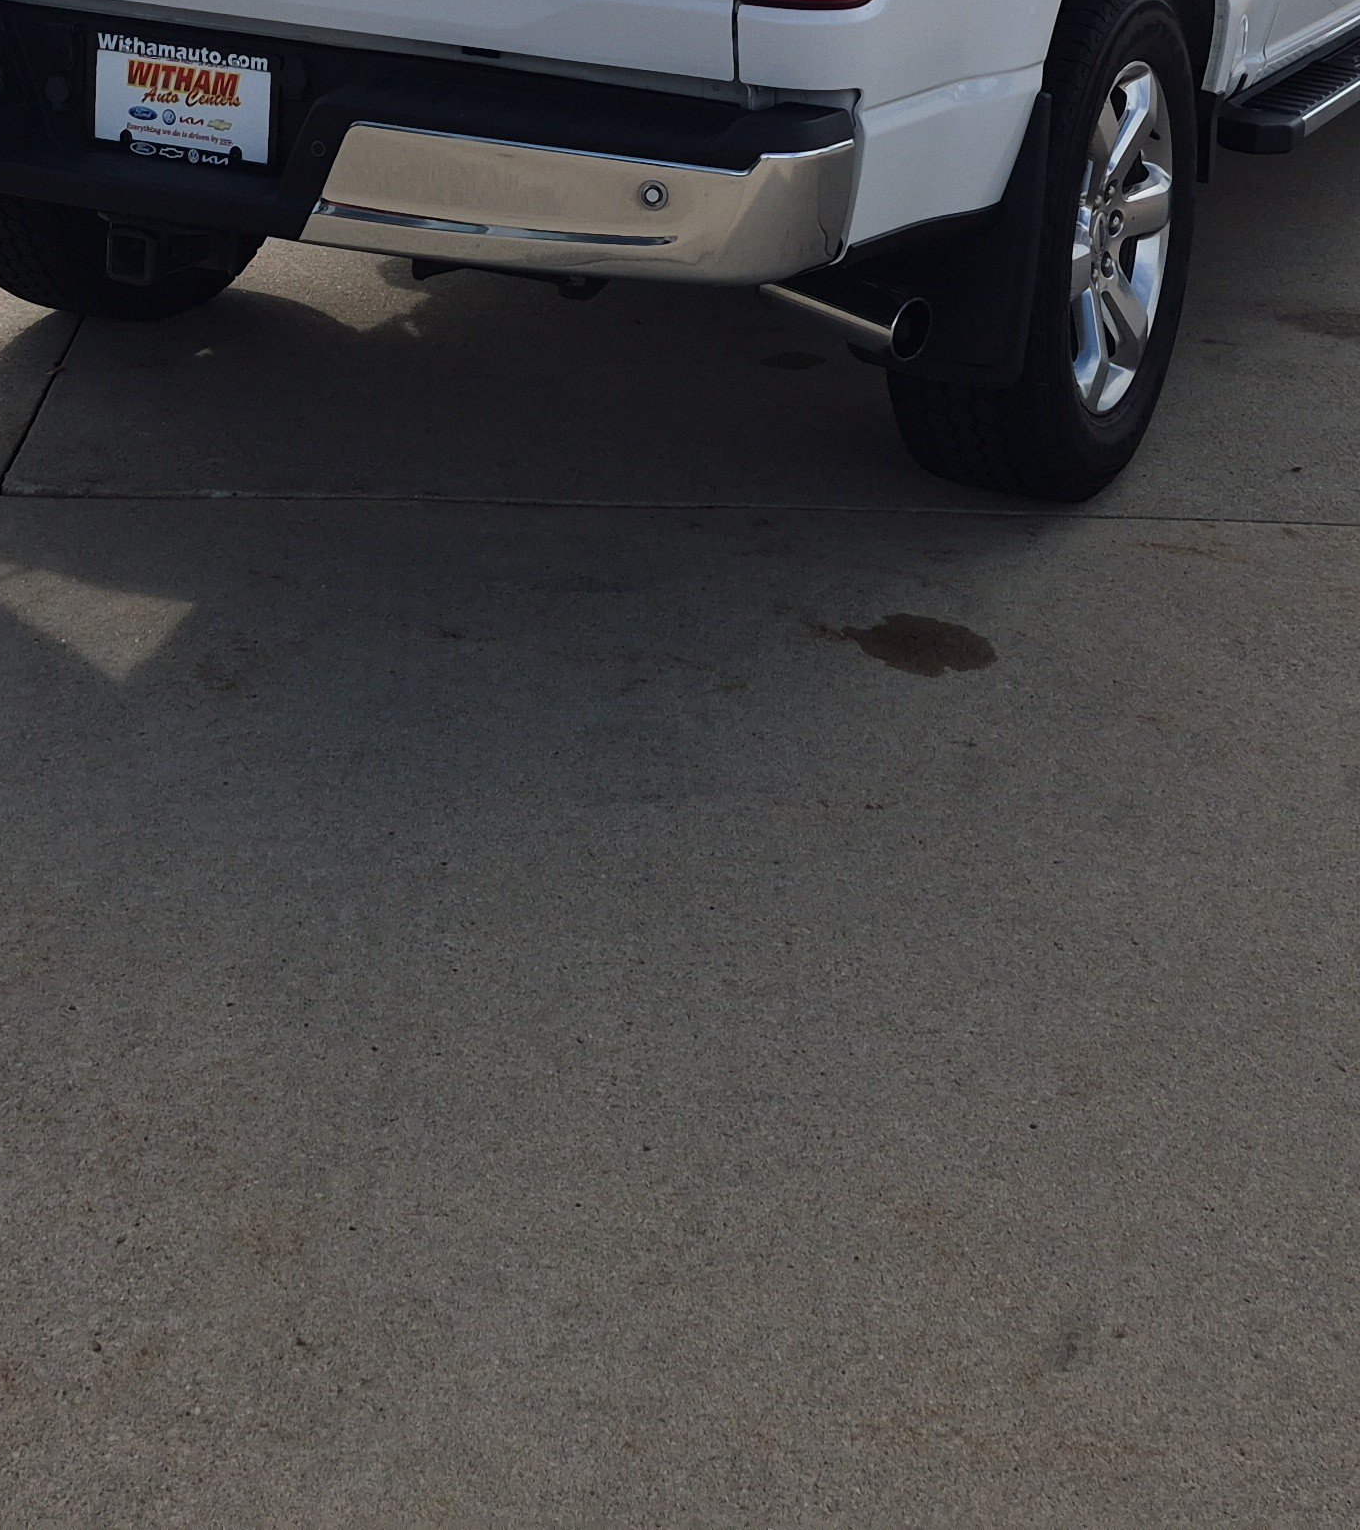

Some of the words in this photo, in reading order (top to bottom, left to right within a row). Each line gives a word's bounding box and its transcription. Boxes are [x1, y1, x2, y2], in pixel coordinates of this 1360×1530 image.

[97, 32, 268, 71] Withamauto.com
[127, 59, 240, 97] WITHAM
[141, 87, 180, 104] Auto
[185, 89, 242, 107] Centers
